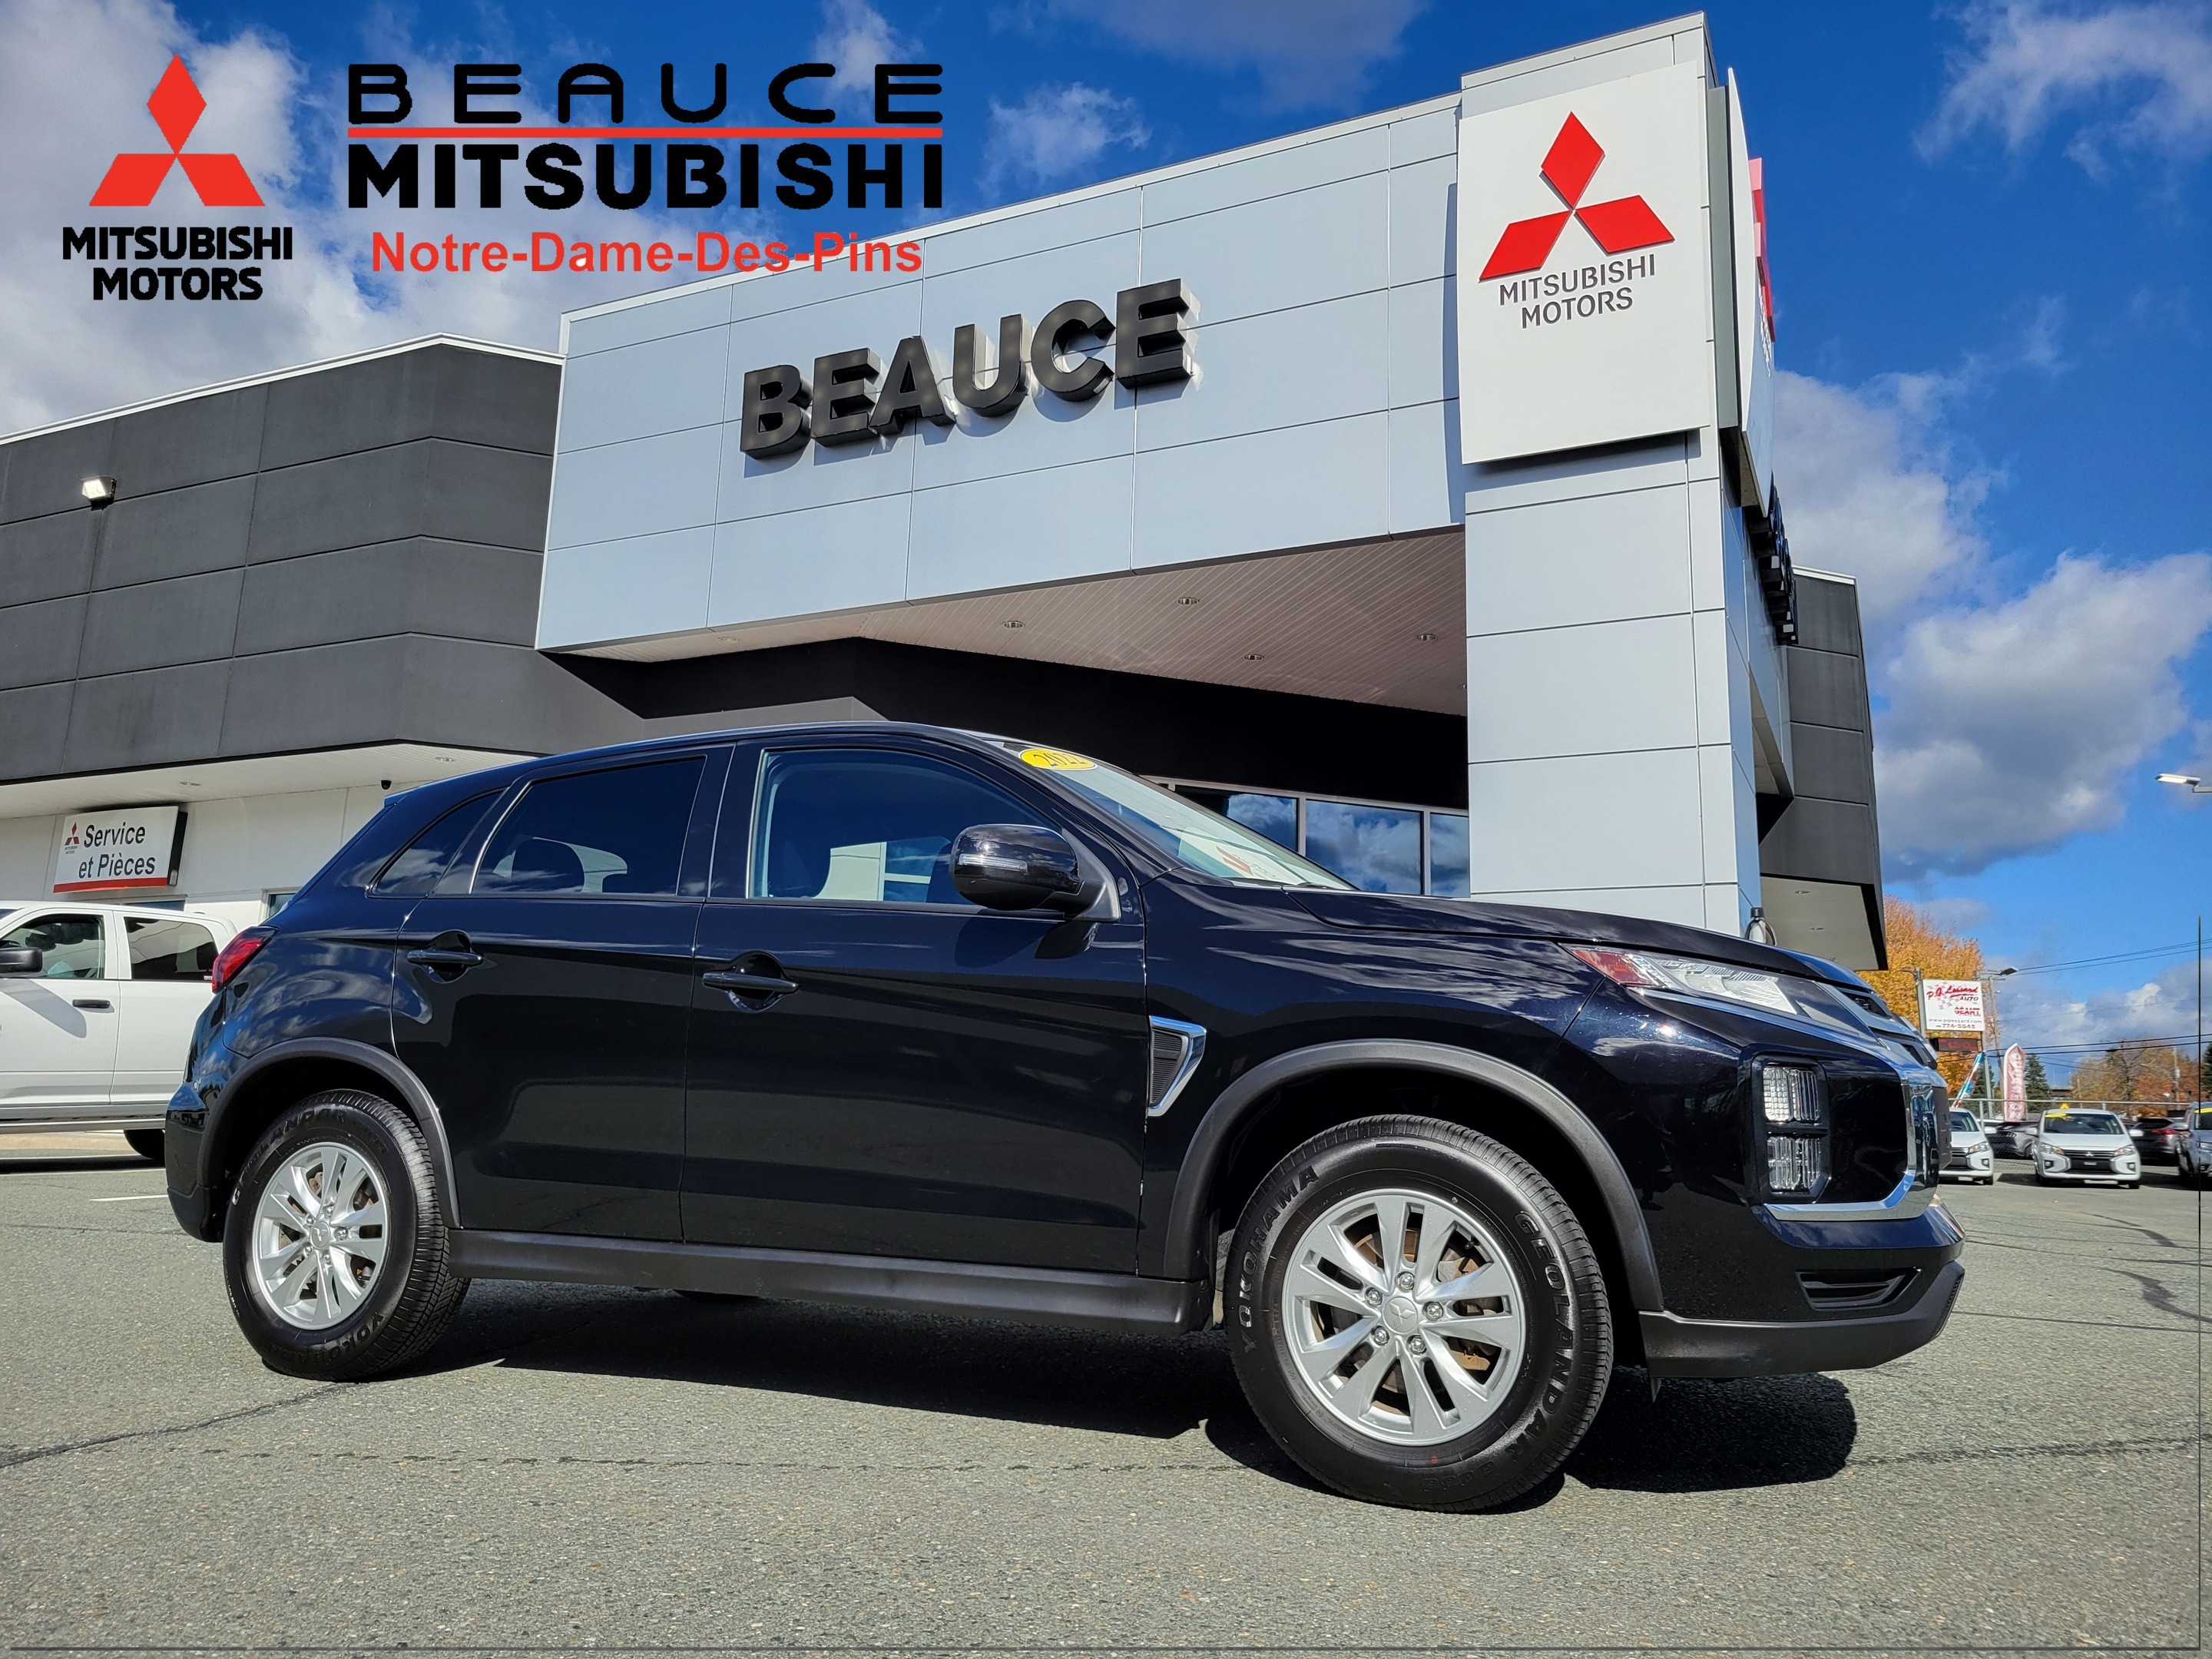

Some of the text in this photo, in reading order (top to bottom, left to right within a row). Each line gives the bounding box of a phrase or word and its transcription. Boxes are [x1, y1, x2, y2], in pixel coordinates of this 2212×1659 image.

[1499, 253, 1656, 306] MITSUBISHI
[1522, 286, 1634, 329] MOTORS
[740, 278, 1194, 459] BEAUCE
[84, 822, 146, 848] Service
[78, 853, 156, 879] et Pièces
[1238, 1165, 1320, 1353] YOKOHAMA
